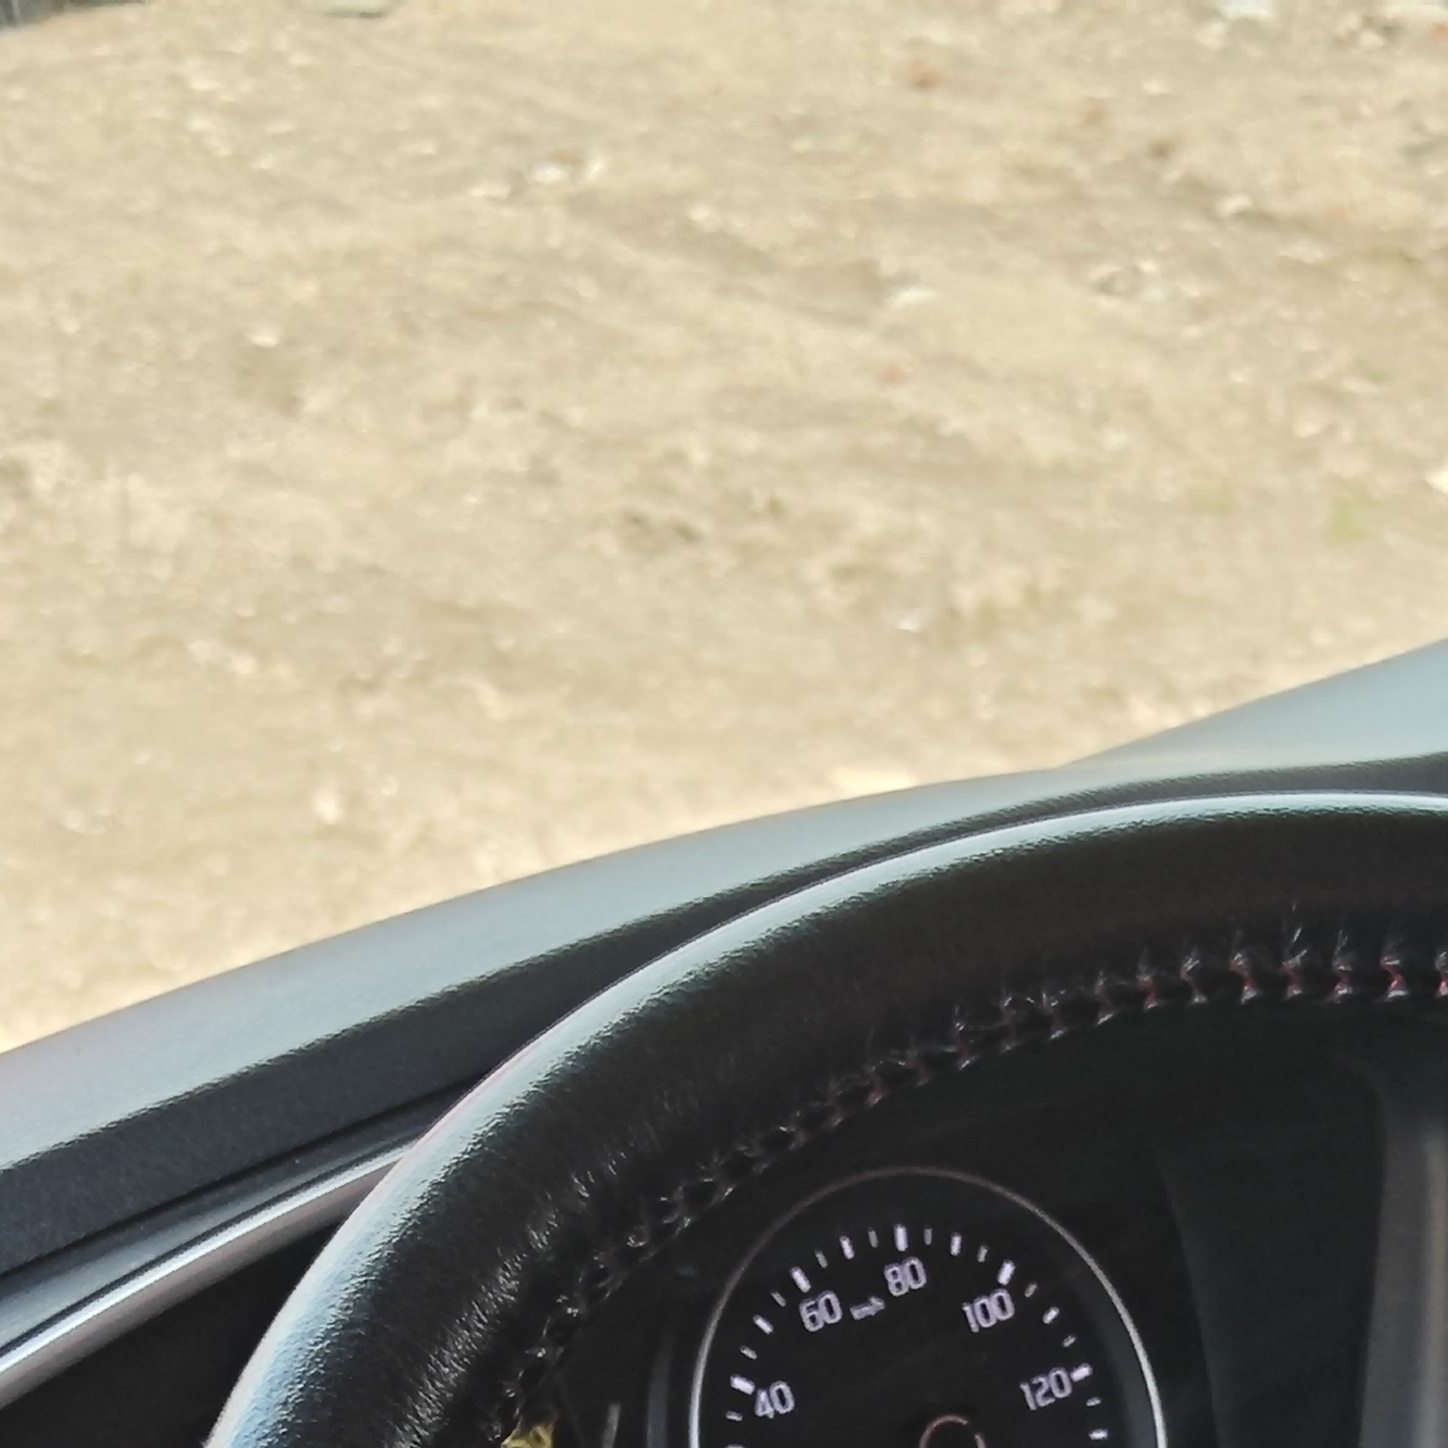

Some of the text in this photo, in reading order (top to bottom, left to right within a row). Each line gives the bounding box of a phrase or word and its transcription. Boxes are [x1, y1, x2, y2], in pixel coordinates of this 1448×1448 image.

[884, 1257, 926, 1298] 80
[798, 1291, 842, 1332] 60
[962, 1287, 1015, 1333] 100
[754, 1380, 795, 1419] 40
[1019, 1367, 1072, 1411] 120
